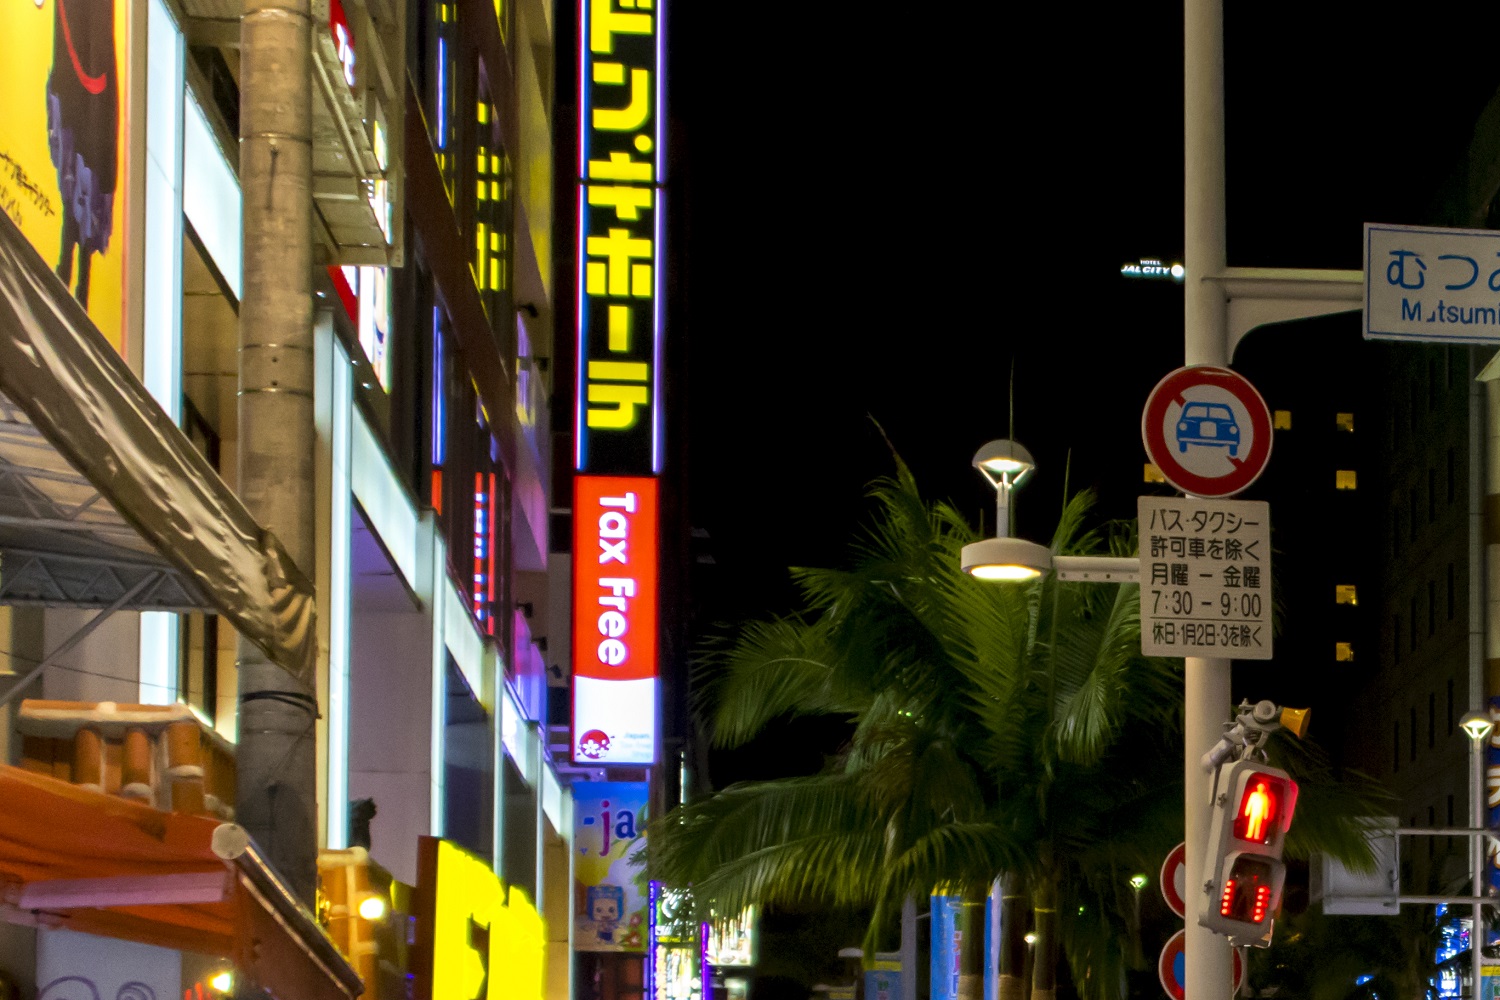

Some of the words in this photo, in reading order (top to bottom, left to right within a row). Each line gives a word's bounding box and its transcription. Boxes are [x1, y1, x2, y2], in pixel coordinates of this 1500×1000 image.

[599, 492, 637, 564] Tax
[1151, 509, 1259, 534] バス・タクシー
[1151, 536, 1259, 561] 許可車を除く
[1152, 591, 1192, 615] 7:30
[1221, 592, 1261, 617] 9:00
[598, 578, 636, 666] Free
